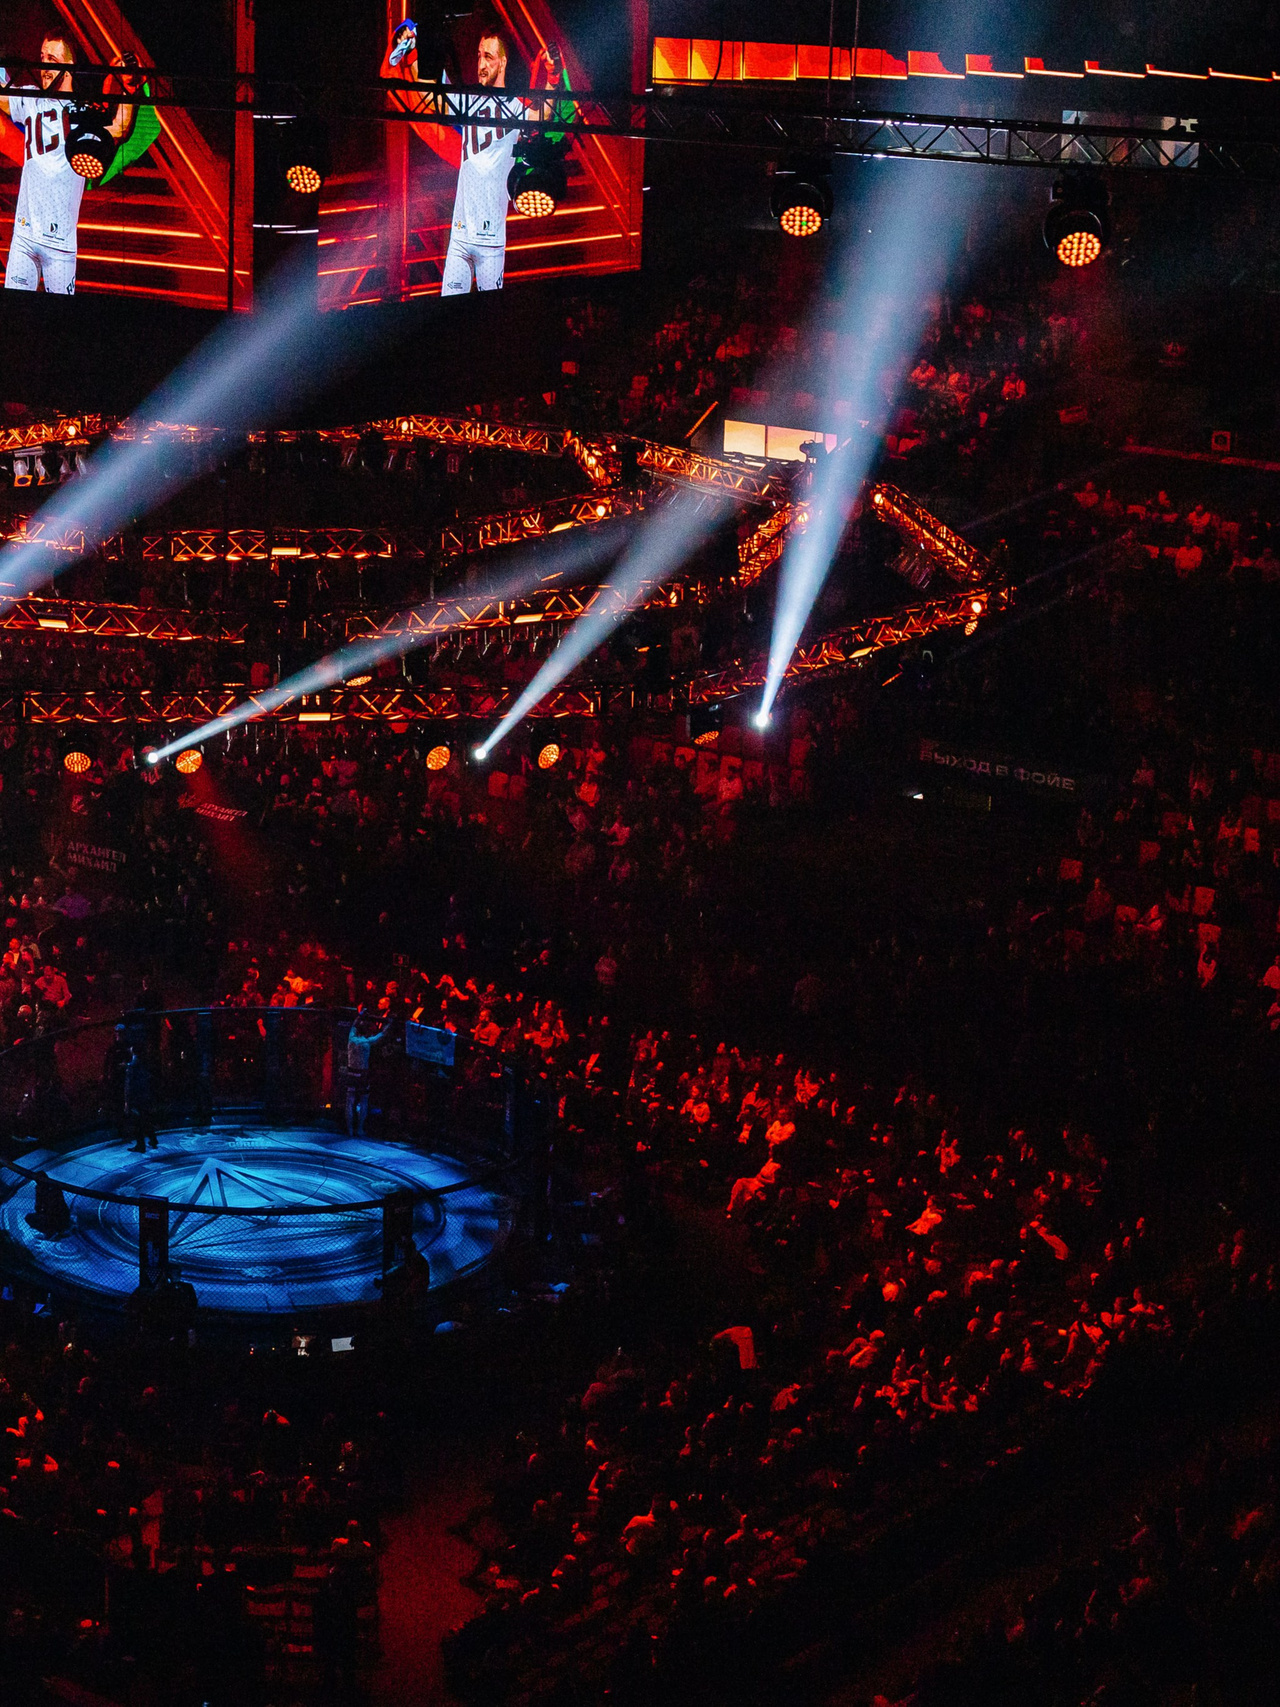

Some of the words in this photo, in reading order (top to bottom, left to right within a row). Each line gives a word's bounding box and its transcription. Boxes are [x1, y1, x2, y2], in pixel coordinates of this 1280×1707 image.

[919, 750, 991, 776] ВЫХОД
[995, 765, 1009, 777] В
[1013, 767, 1077, 791] ФОЙЕ
[67, 840, 128, 864] АРХАНГЕЛ
[67, 852, 118, 873] МИХАИЛ
